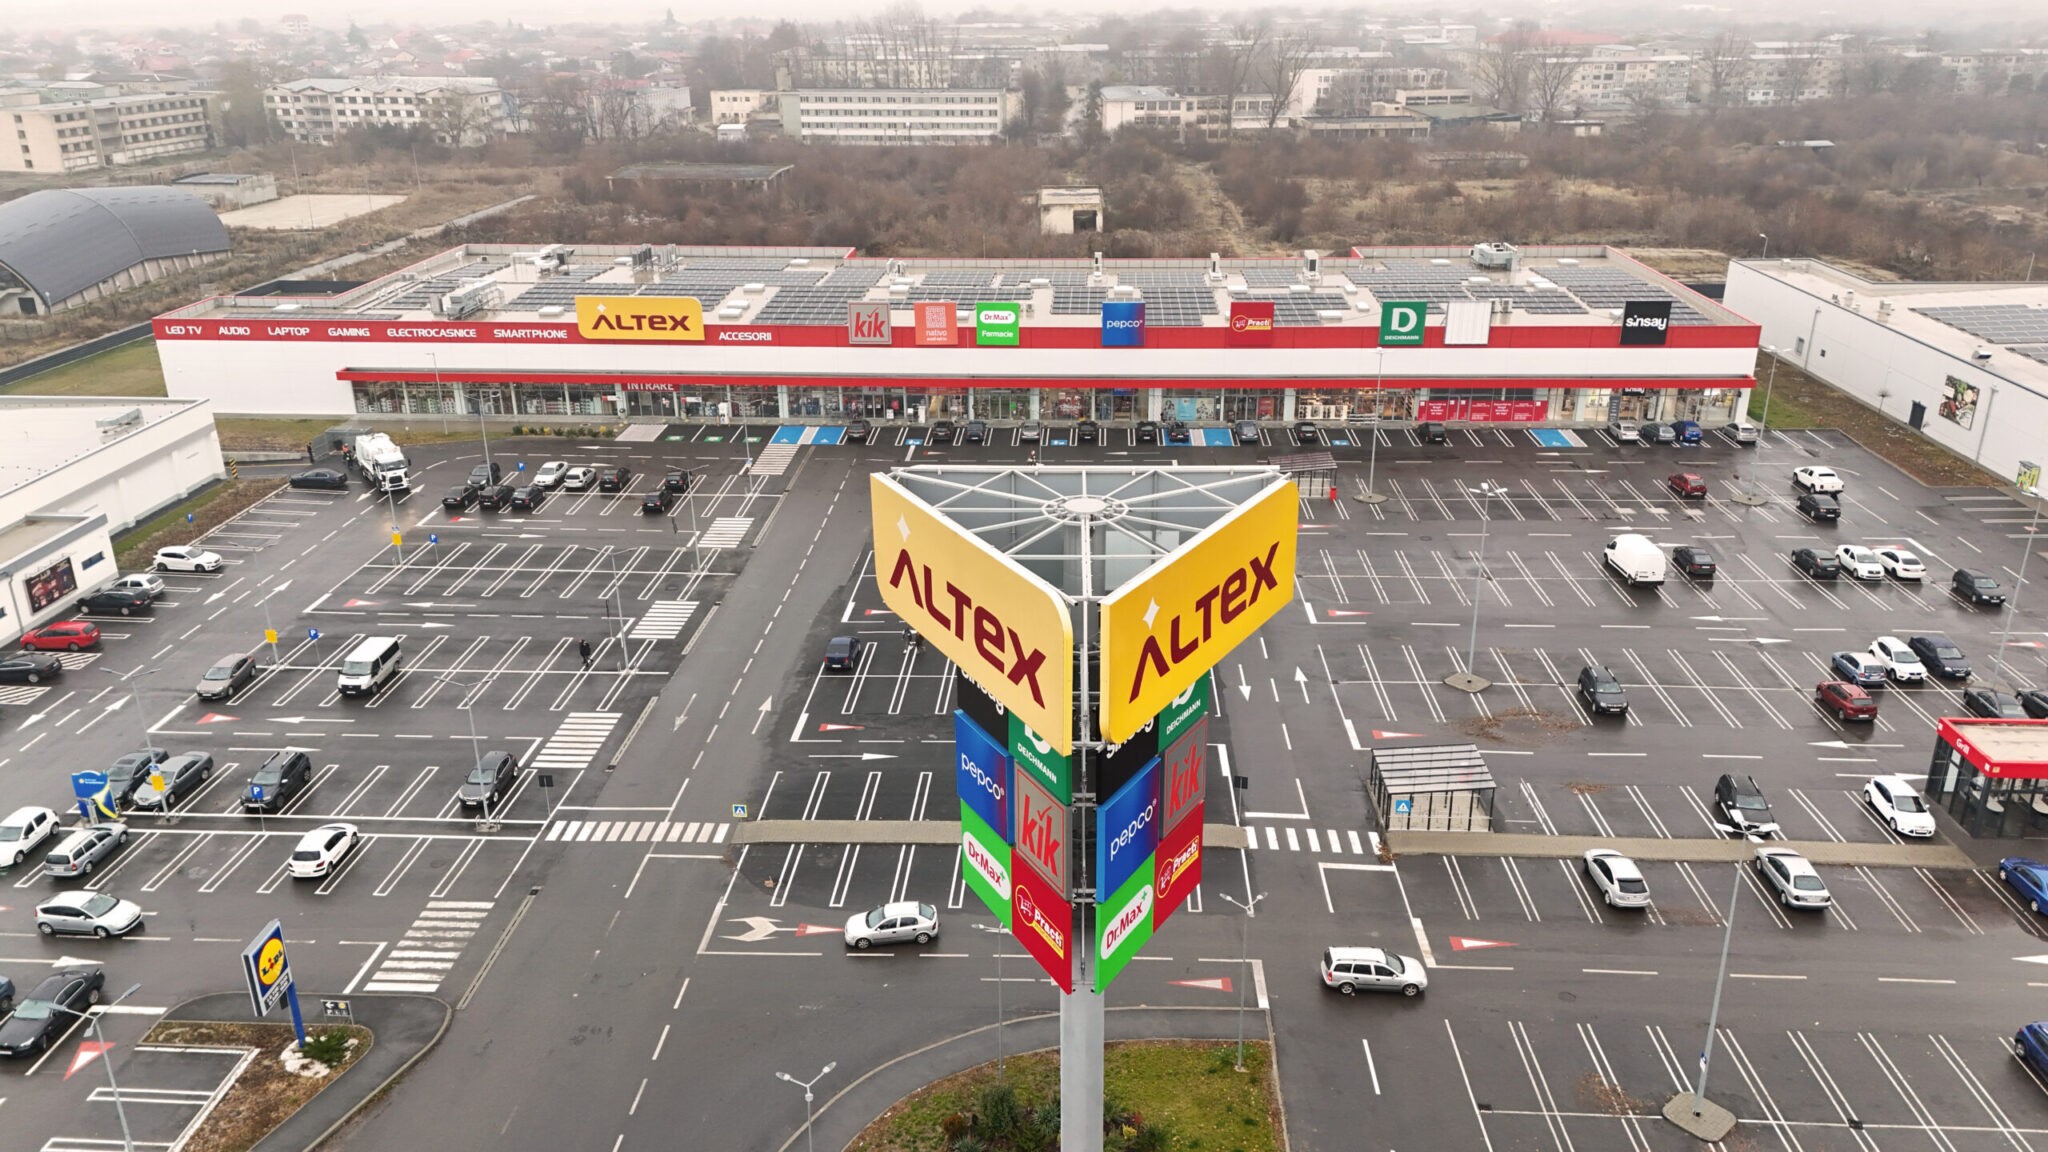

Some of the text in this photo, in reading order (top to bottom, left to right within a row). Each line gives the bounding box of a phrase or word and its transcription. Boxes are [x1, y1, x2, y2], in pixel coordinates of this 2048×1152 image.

[1106, 319, 1140, 329] pepco
[1247, 319, 1271, 327] Practi
[1391, 307, 1418, 332] D
[1625, 315, 1667, 330] sinsay
[165, 325, 202, 335] LED TV
[218, 326, 250, 336] AUDIO
[267, 326, 310, 336] LAPTOP
[327, 327, 370, 337] GAMING
[387, 328, 477, 338] ELECTROCASNICE
[493, 328, 568, 339] SMARTPHONE
[718, 331, 772, 341] ACCESORII
[981, 329, 1014, 338] Farmacie
[1166, 699, 1201, 735] DEICHMANN
[1956, 738, 1971, 755] Grill
[1017, 742, 1057, 784] DEICHMANN
[961, 752, 1001, 800] pepco
[1110, 805, 1153, 862] pepco
[1172, 840, 1199, 873] Practi
[968, 841, 1001, 888] Dr.Max
[1034, 908, 1062, 948] Practi
[1106, 901, 1143, 950] Dr.Max
